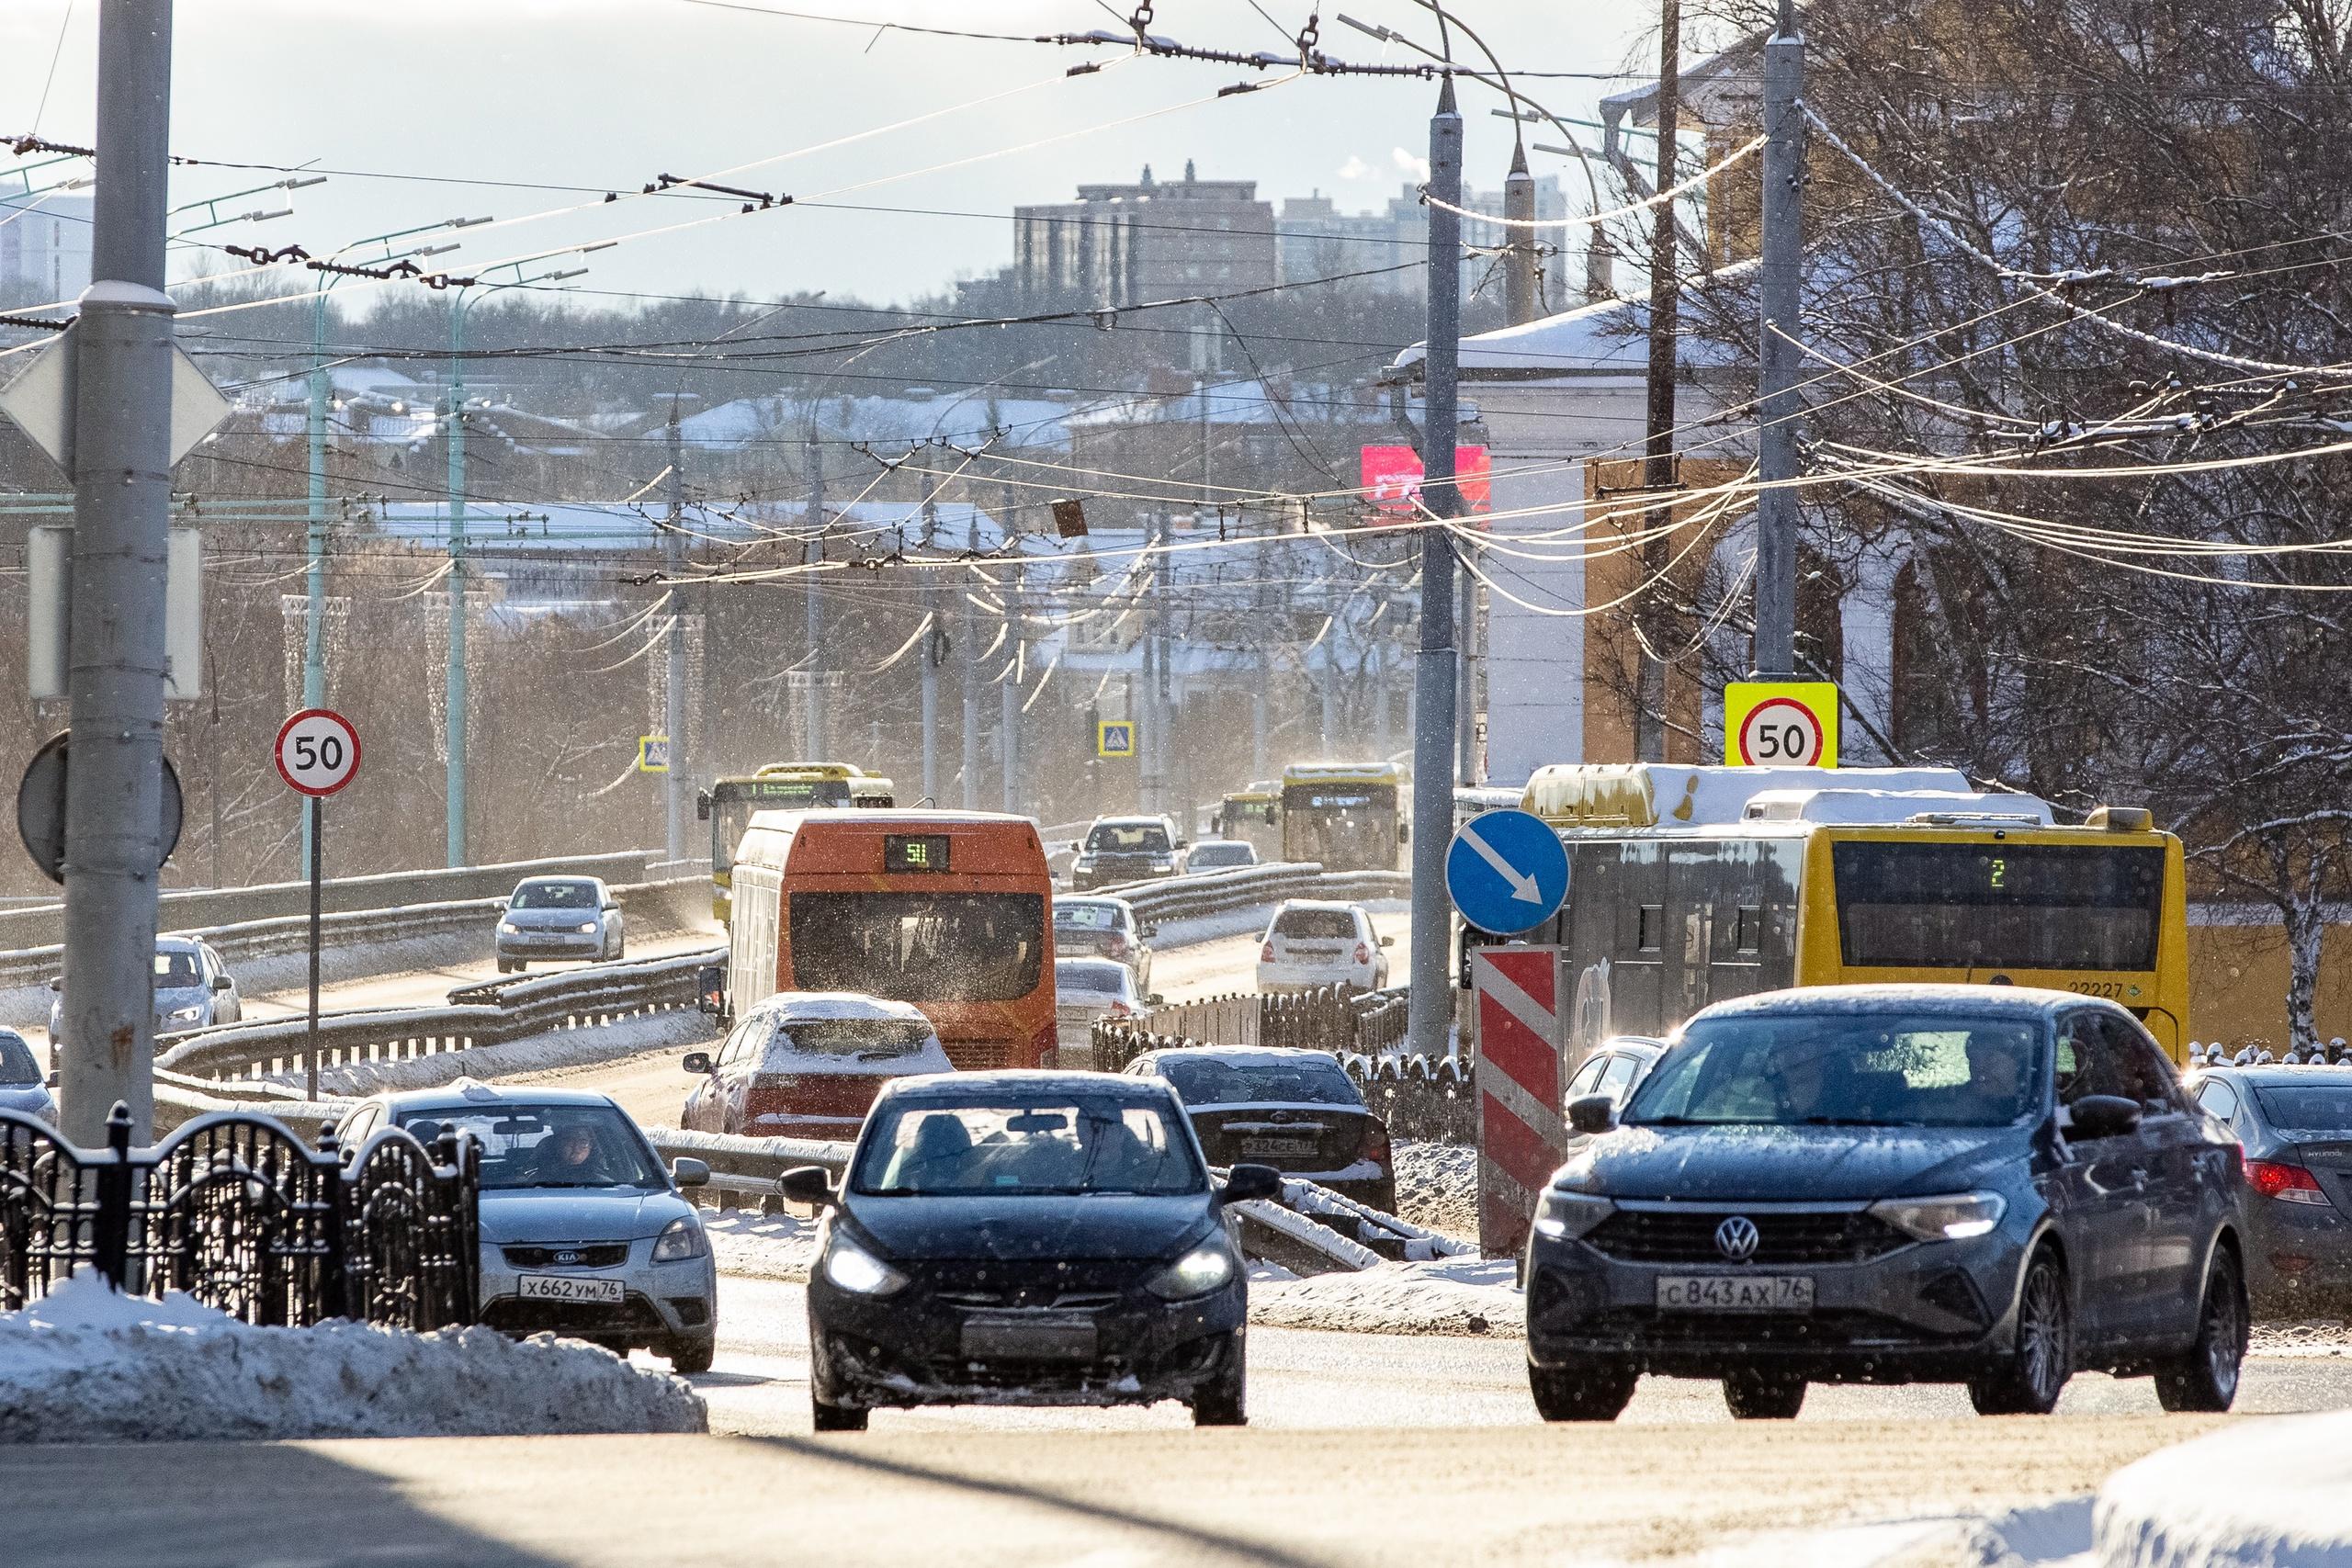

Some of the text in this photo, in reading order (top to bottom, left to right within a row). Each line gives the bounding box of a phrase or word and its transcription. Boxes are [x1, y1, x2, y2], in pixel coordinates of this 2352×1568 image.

[295, 736, 343, 770] 50
[1758, 724, 1805, 759] 50
[1992, 860, 2005, 887] 2
[2069, 982, 2123, 998] 22227
[558, 1253, 576, 1262] KIA
